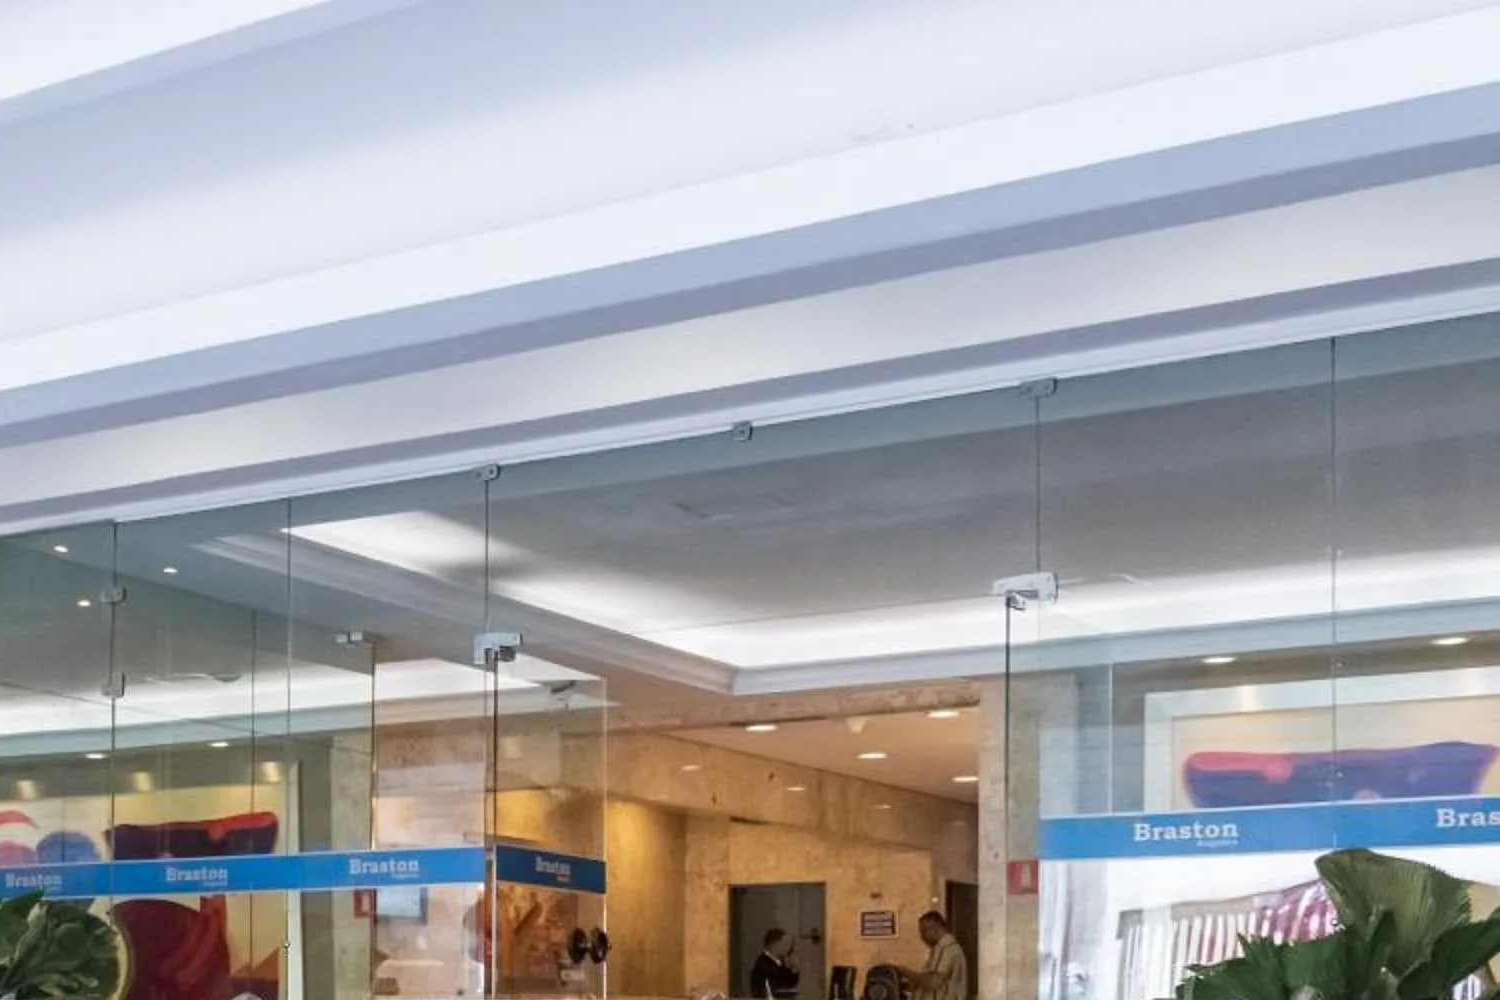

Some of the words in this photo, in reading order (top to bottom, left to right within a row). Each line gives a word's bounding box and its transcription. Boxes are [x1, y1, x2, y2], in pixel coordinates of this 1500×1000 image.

[1134, 821, 1238, 842] Braston
[166, 866, 228, 882] Braston
[349, 858, 420, 875] Braston
